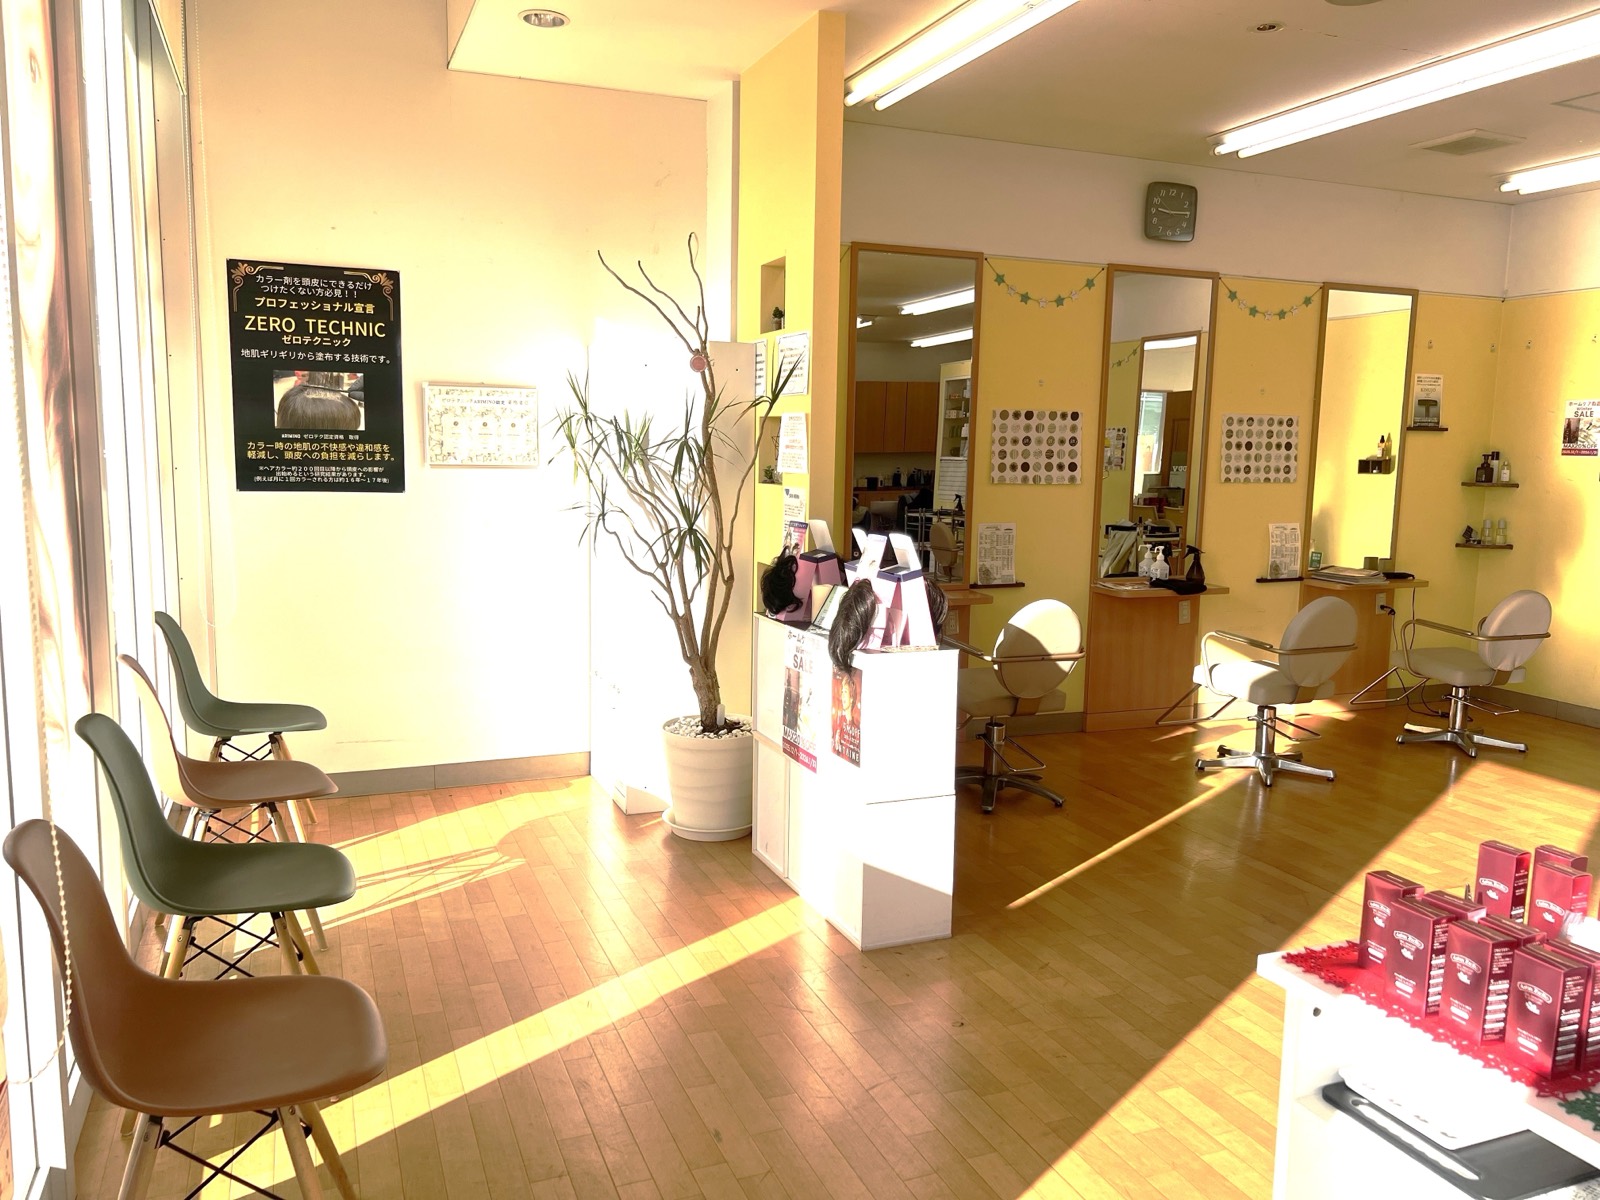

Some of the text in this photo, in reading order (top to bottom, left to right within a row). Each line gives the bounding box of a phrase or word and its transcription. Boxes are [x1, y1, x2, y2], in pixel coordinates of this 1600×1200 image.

[256, 274, 373, 291] カラー剤を頭皮にできるだけ
[255, 296, 375, 314] プロフェッショナル宣言
[244, 315, 386, 338] ZERO TECHNIC
[282, 334, 352, 347] ゼロテクニック
[241, 348, 391, 365] 地肌ギリギリから塗布する技術です。
[247, 441, 391, 453] カラー時の地肌の不快感や違和感を
[247, 450, 396, 462] 軽減し、頭皮への負担を減らします。
[793, 654, 814, 674] SALE
